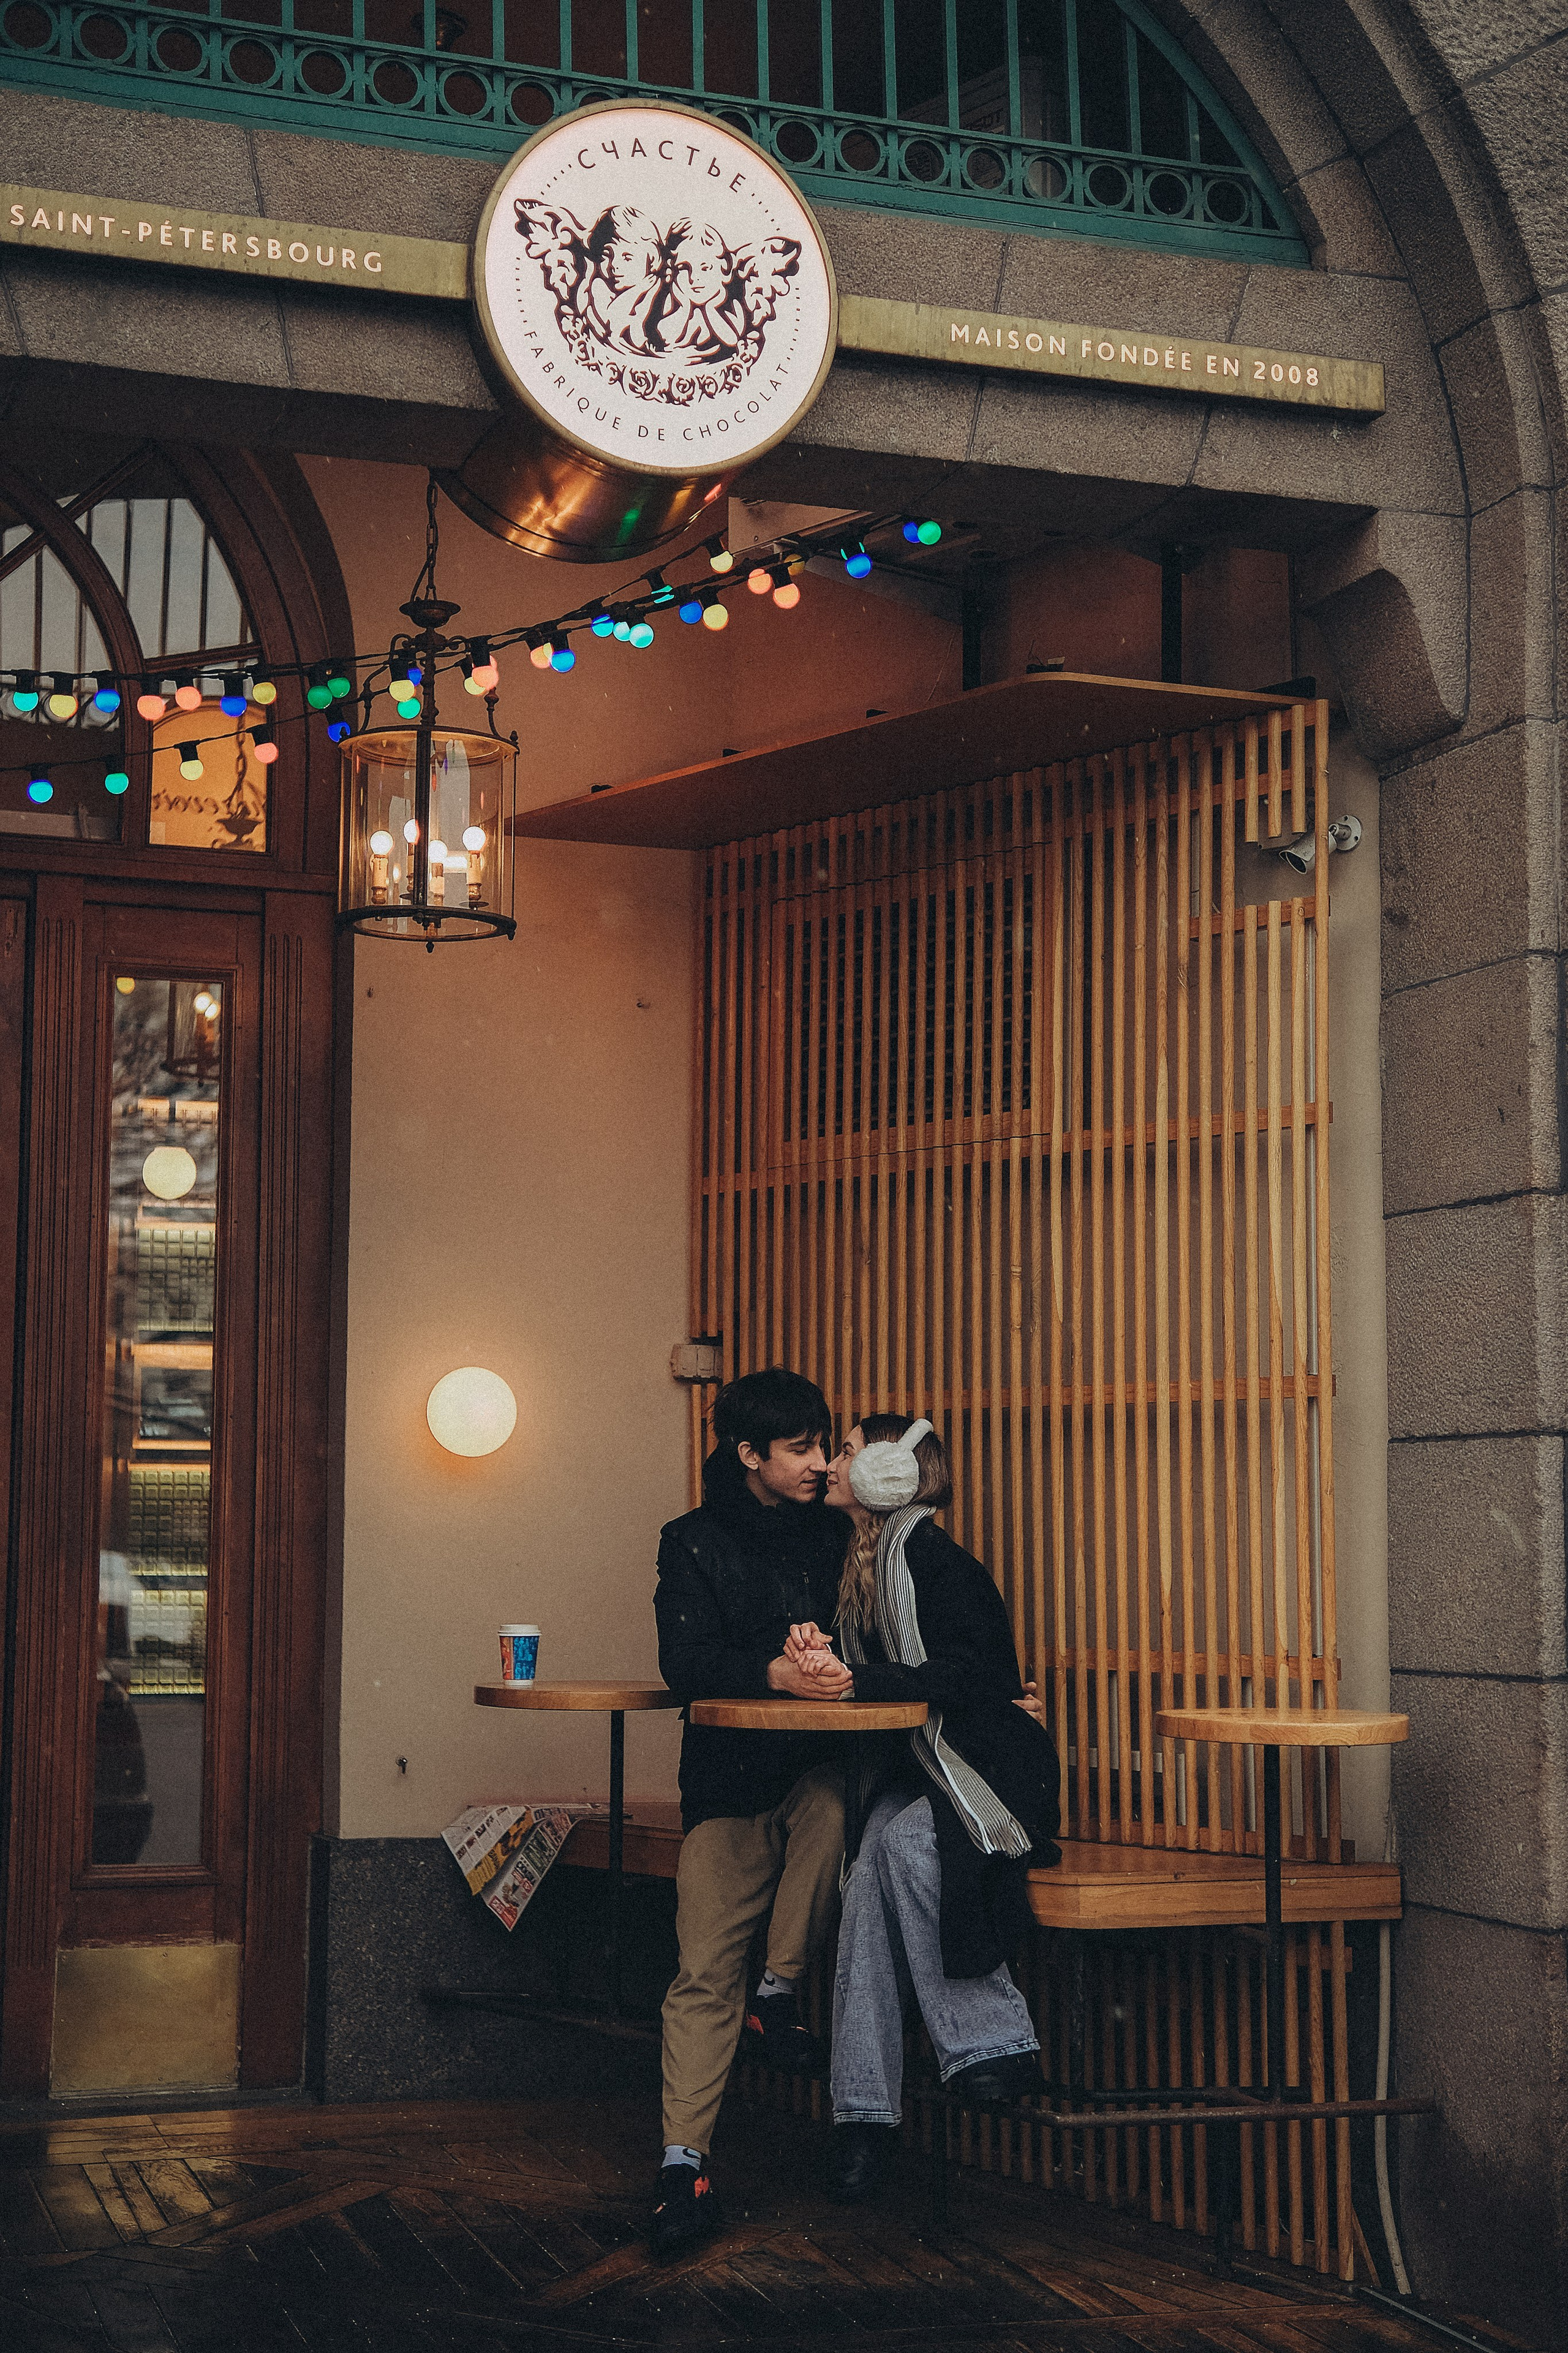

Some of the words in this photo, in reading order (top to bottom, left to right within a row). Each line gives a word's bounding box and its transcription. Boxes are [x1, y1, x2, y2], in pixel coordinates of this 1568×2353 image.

[578, 137, 746, 193] СЧАСТЬЕ
[9, 203, 383, 273] SAINT-PÉTERSBOURG
[523, 331, 622, 431] FABRIQUE
[638, 425, 666, 441] DE
[683, 364, 790, 441] CHOCOLAT
[950, 323, 1067, 356] MAISON
[1082, 339, 1193, 371] FONDÉE
[1207, 355, 1240, 377] EN
[1253, 360, 1321, 387] 2008
